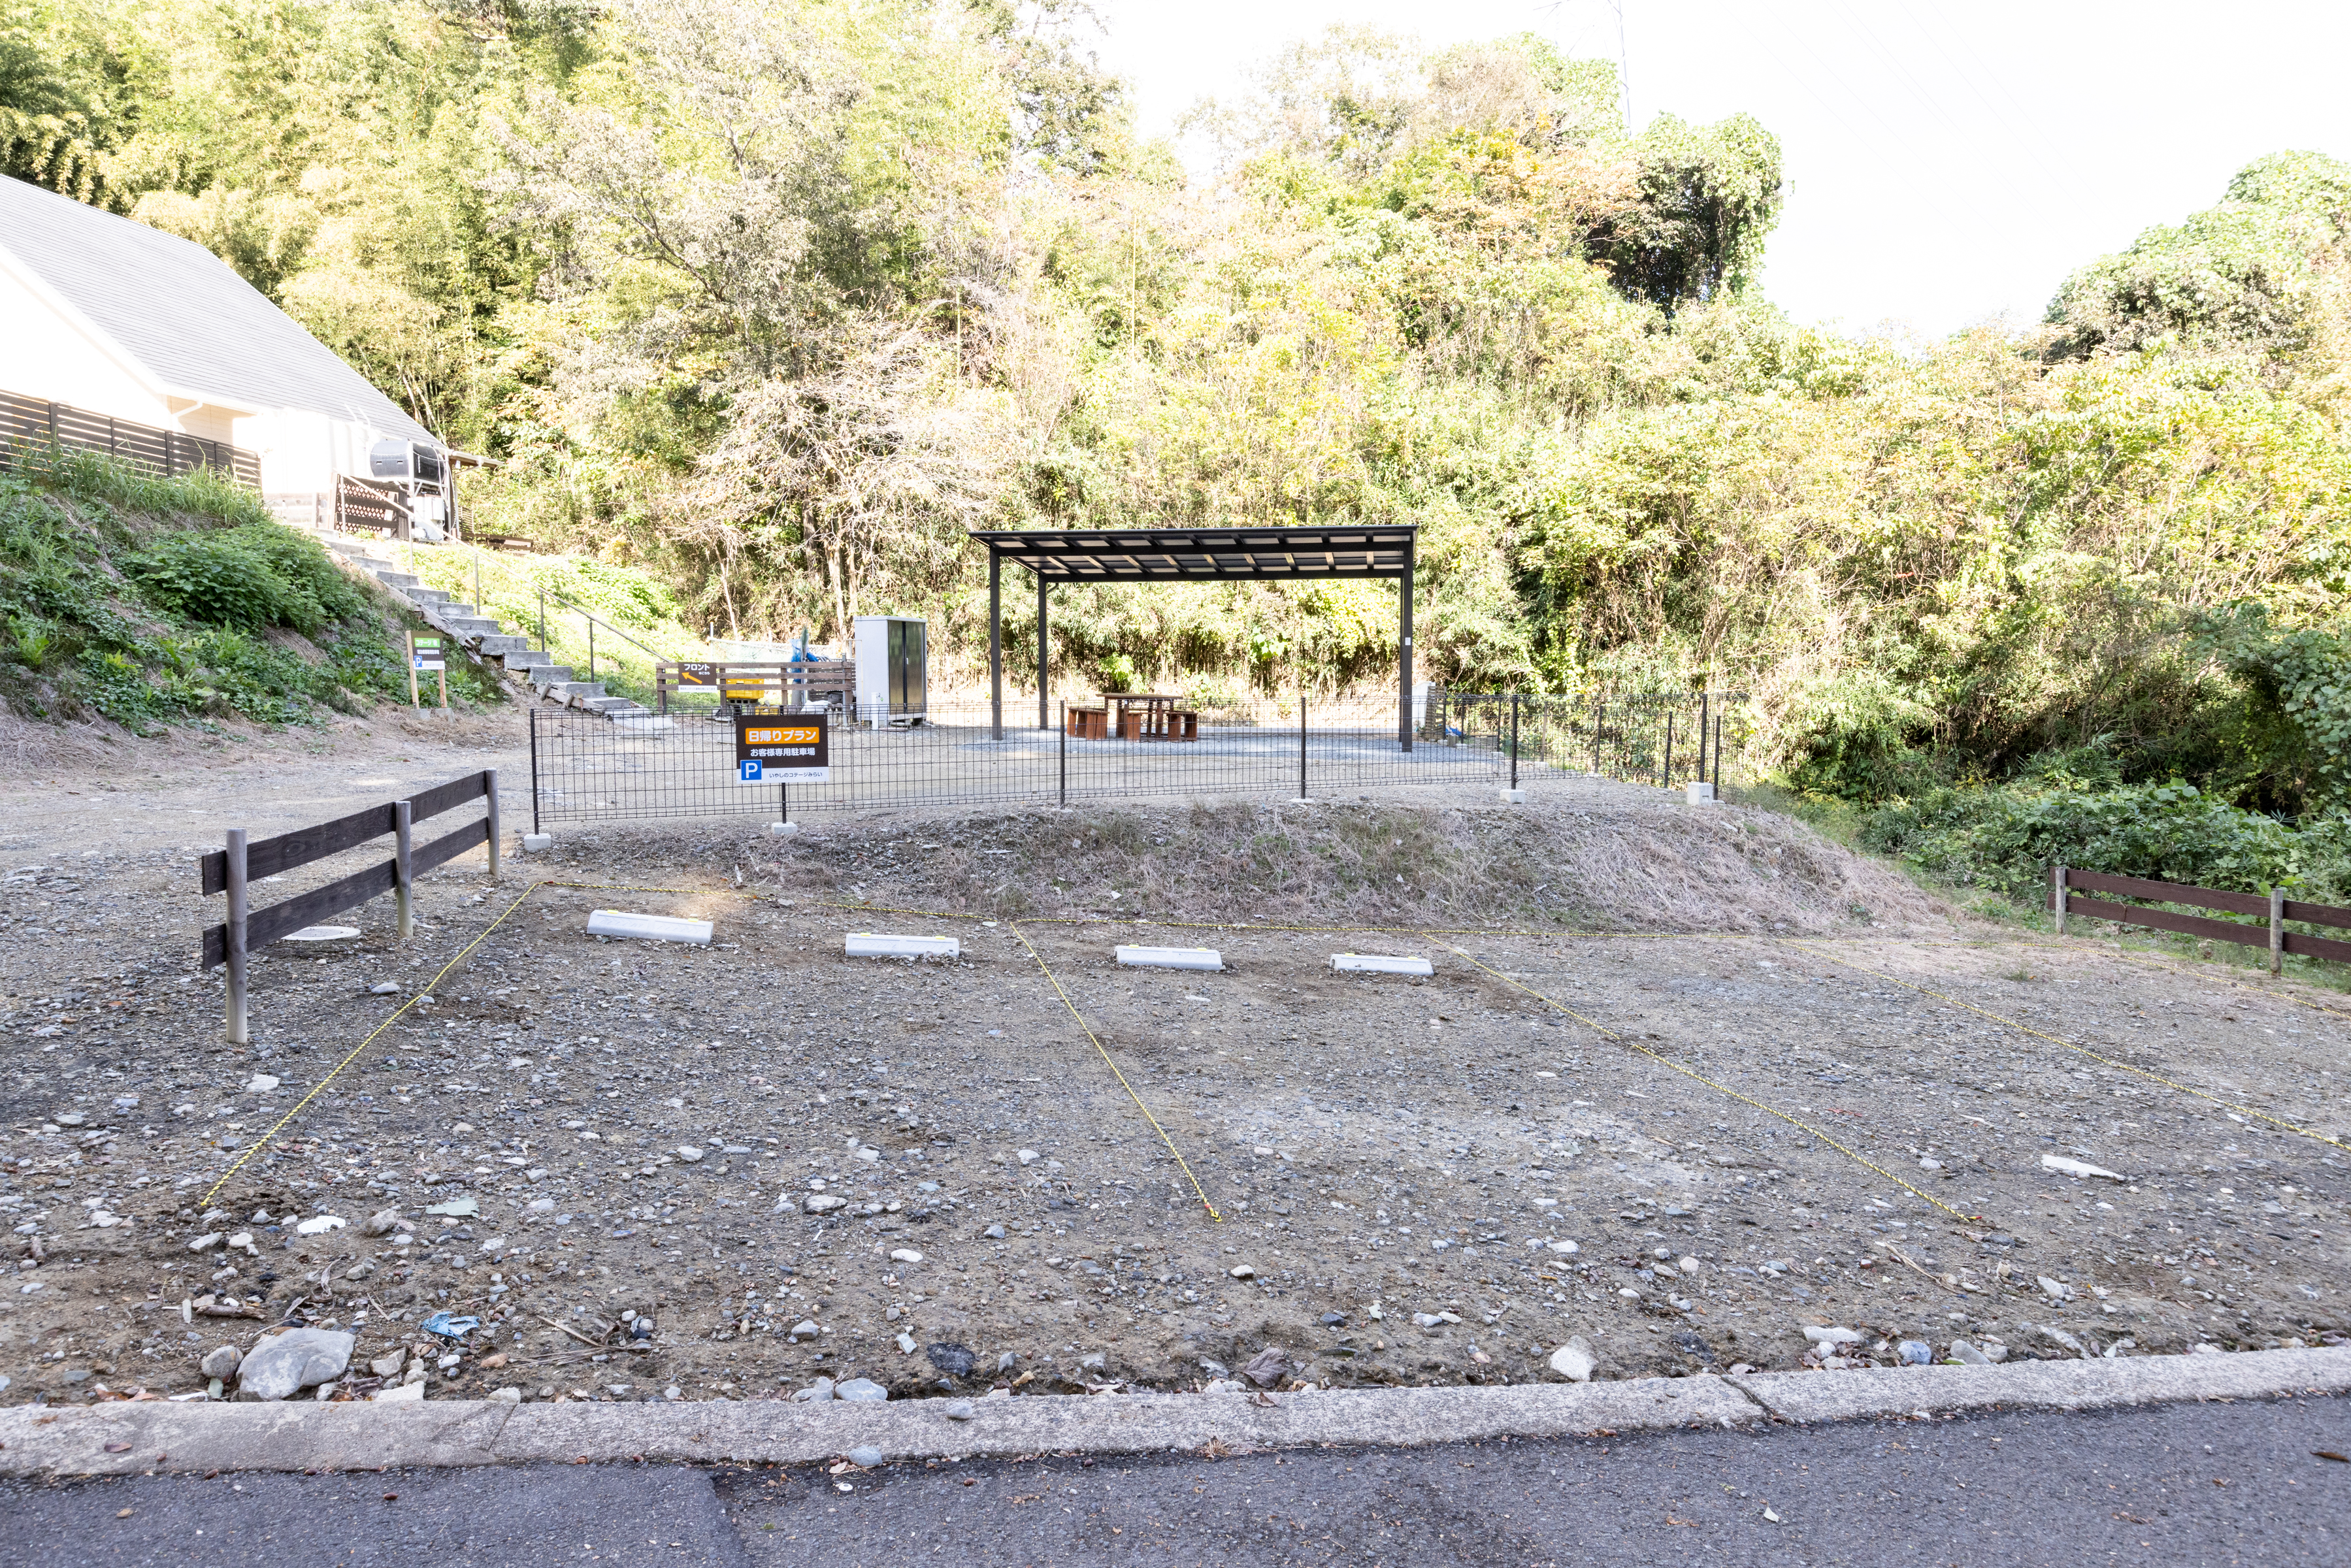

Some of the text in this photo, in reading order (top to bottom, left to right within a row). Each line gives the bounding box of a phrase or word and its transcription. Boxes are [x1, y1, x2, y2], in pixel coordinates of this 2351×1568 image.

[416, 657, 421, 667] P
[749, 730, 816, 742] 日帰りプラン
[750, 747, 815, 757] お客様専用駐車場
[746, 762, 758, 779] P
